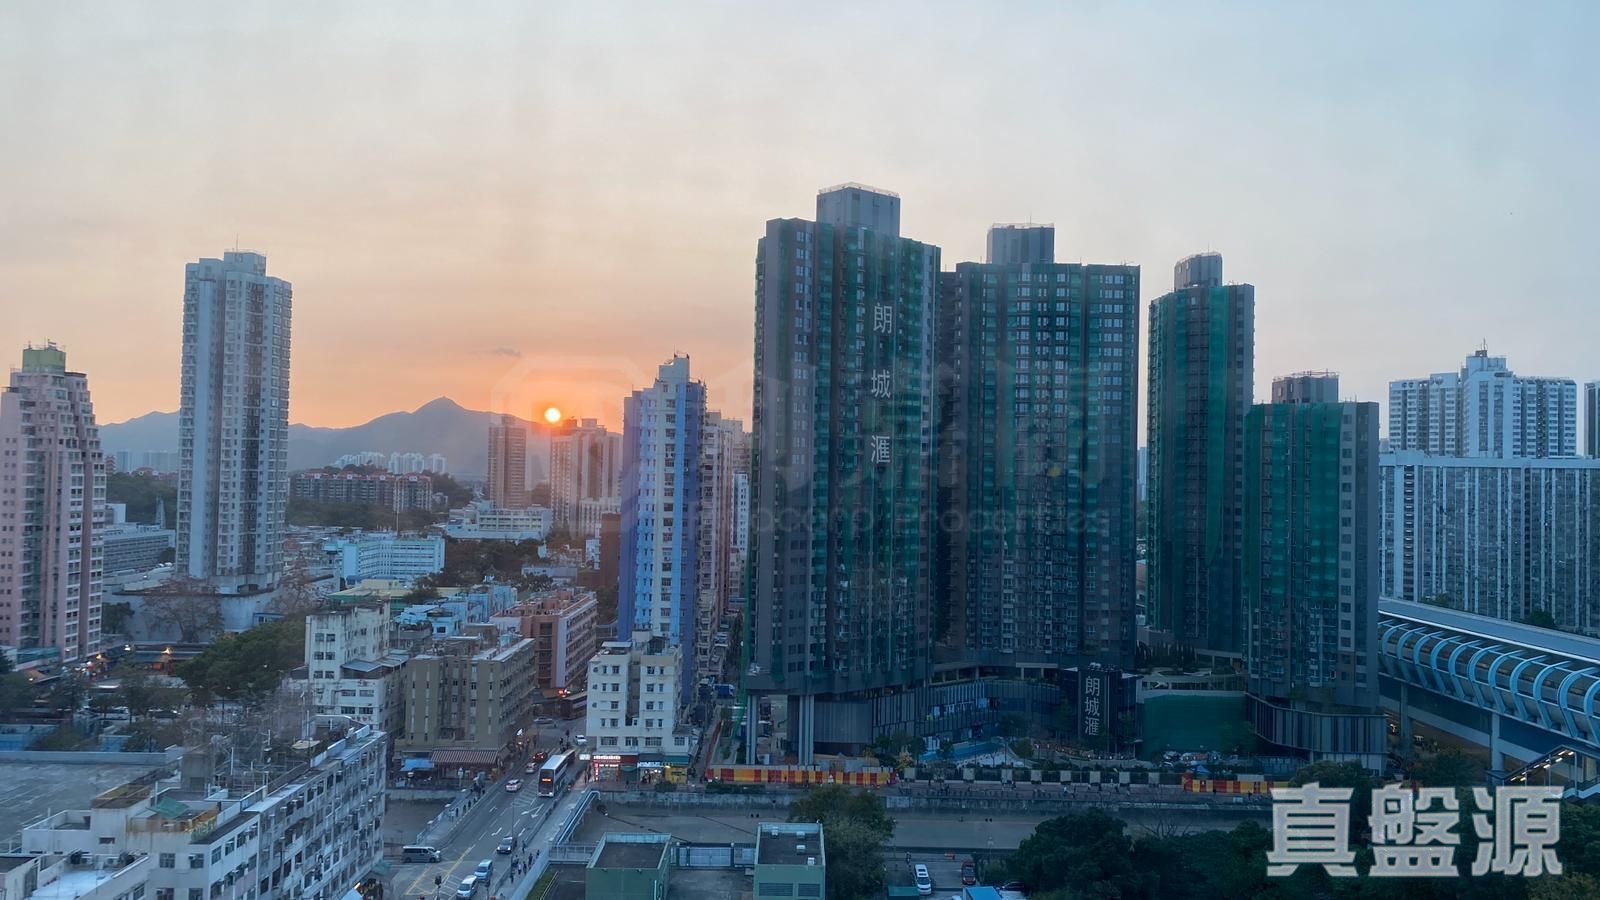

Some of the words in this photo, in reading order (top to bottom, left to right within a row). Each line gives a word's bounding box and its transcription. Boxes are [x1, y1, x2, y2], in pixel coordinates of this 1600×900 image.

[871, 302, 893, 464] 朗城滙
[1085, 676, 1100, 736] 朗城滙
